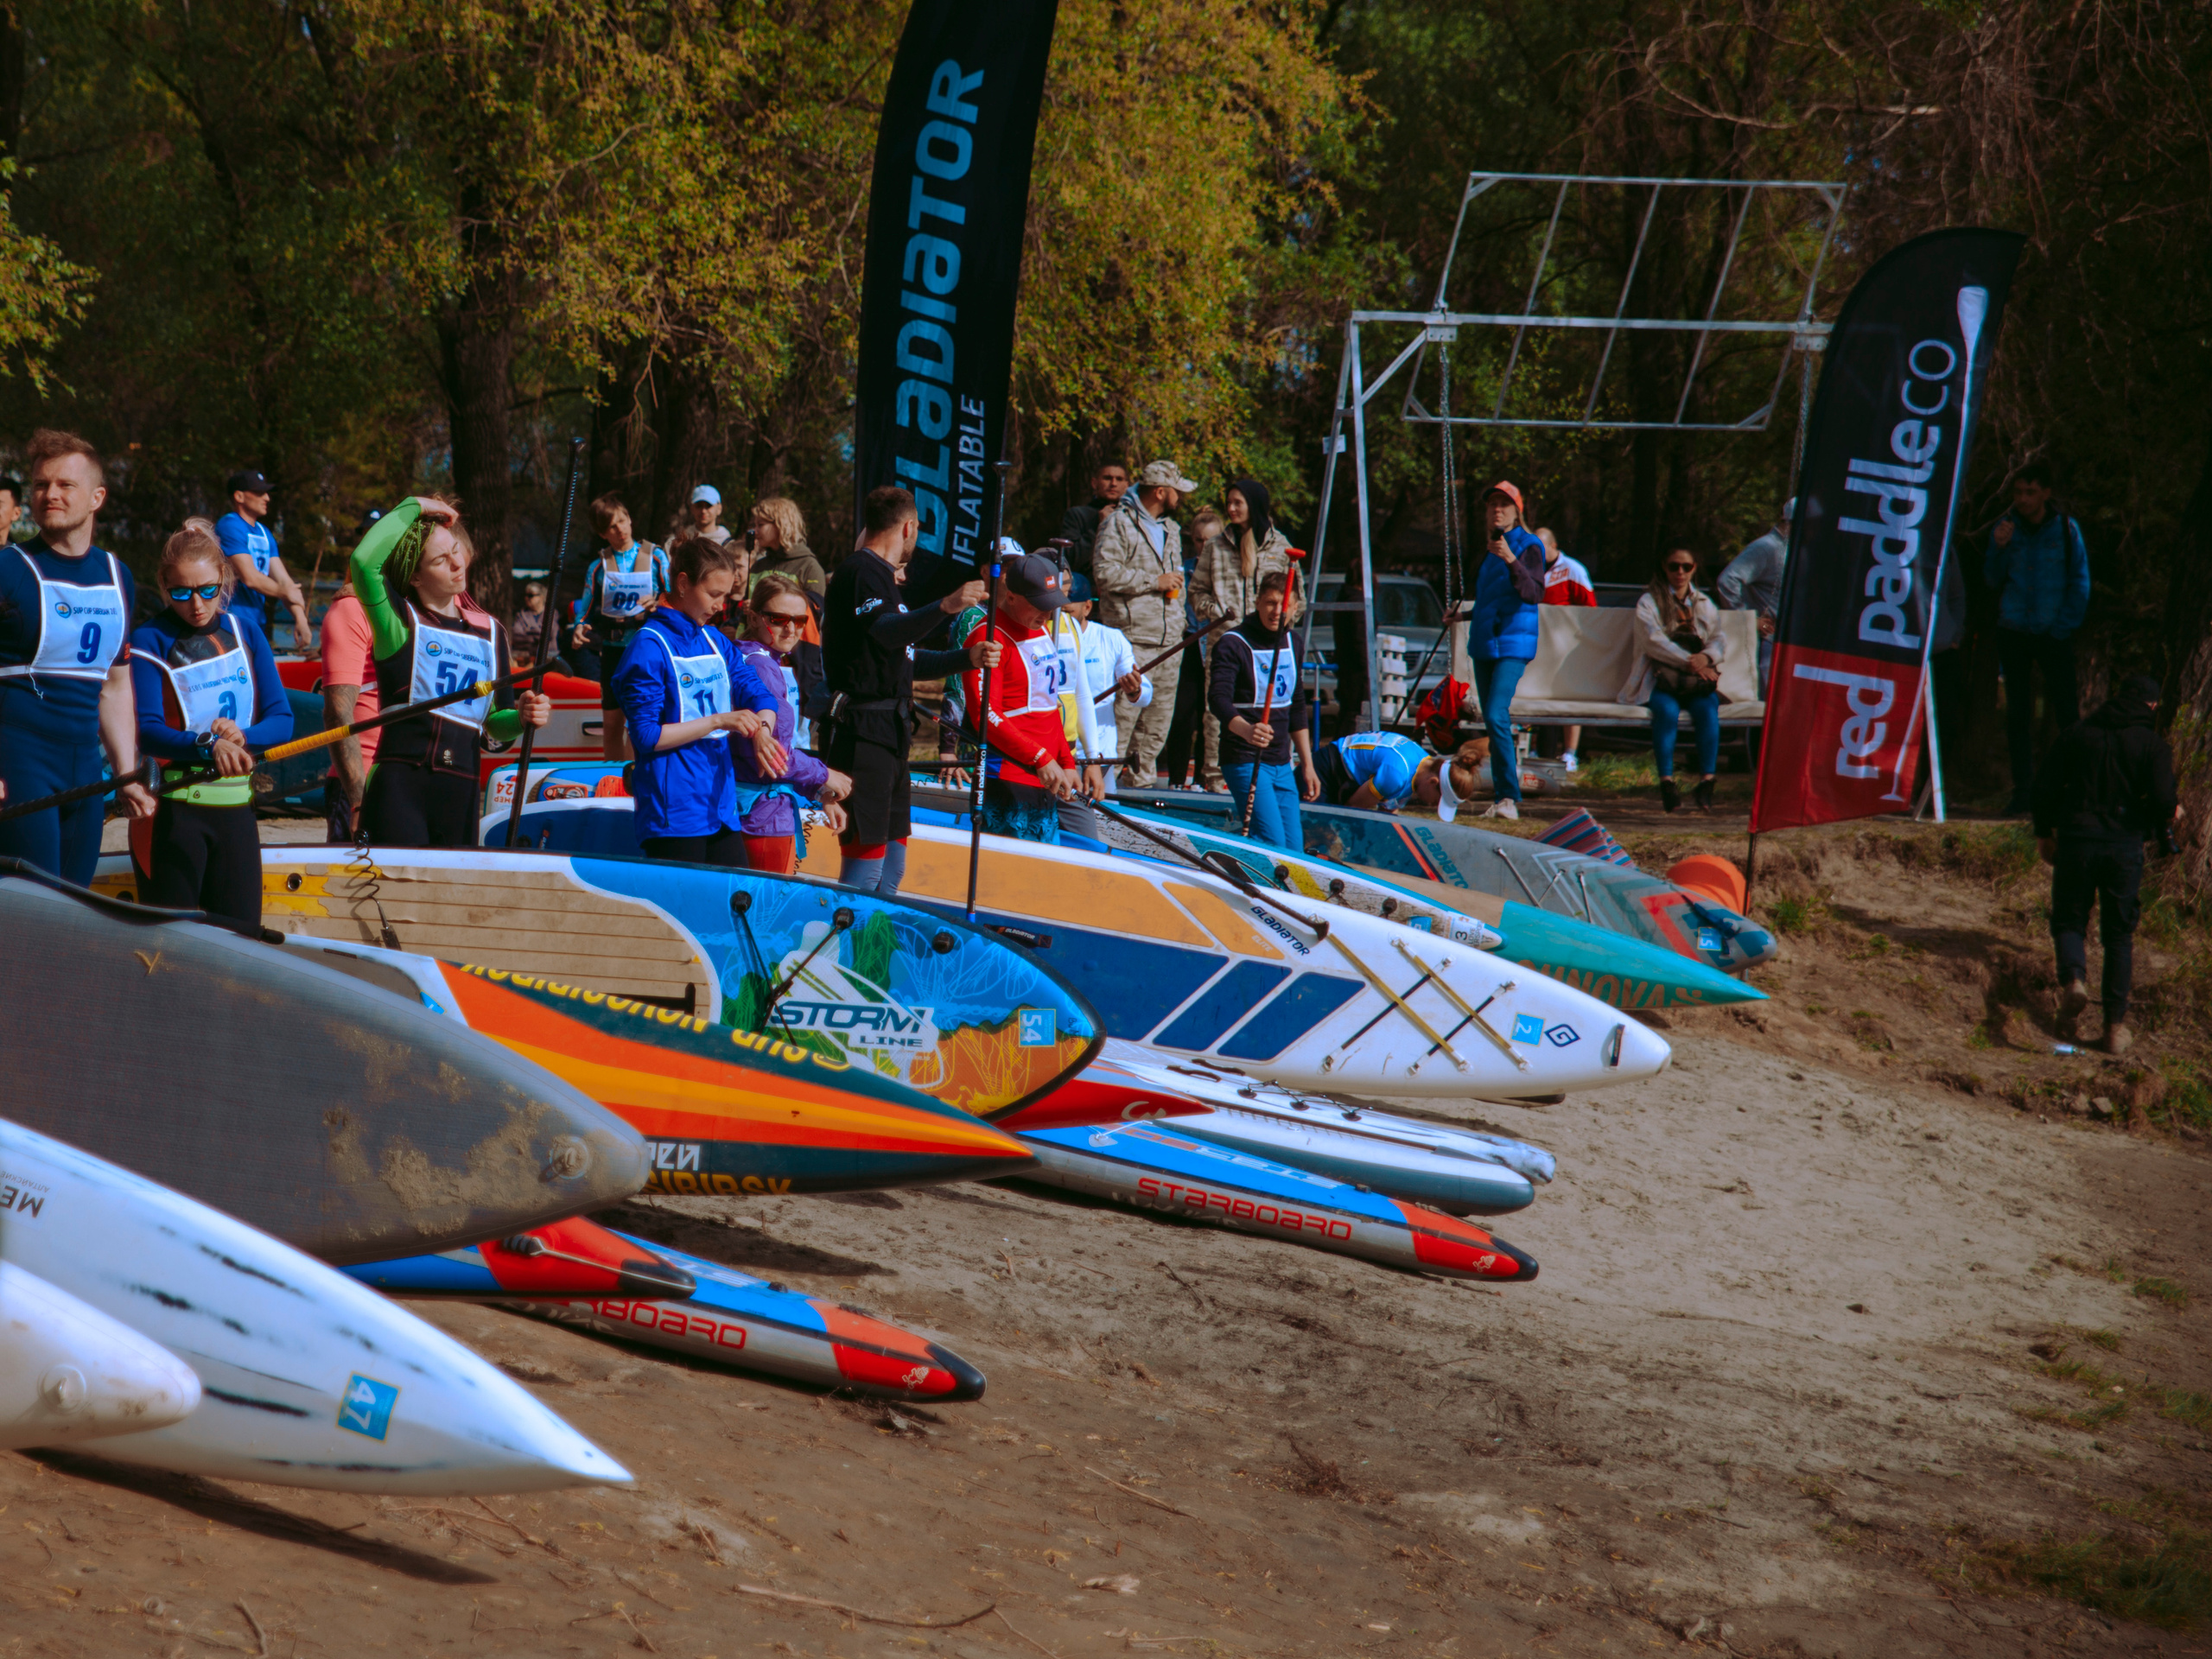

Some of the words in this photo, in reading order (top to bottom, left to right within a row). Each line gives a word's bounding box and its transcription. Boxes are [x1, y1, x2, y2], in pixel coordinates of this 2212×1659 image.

[77, 622, 101, 664] 9
[435, 660, 479, 706] 54
[693, 688, 718, 718] 11
[1792, 664, 1895, 779] red
[496, 781, 514, 796] 24
[1454, 931, 1468, 941] 3
[771, 1001, 927, 1033] STORM
[1021, 1013, 1042, 1043] 54
[1516, 1021, 1532, 1034] 2
[860, 1035, 924, 1047] LINE
[346, 1380, 377, 1430] 47
